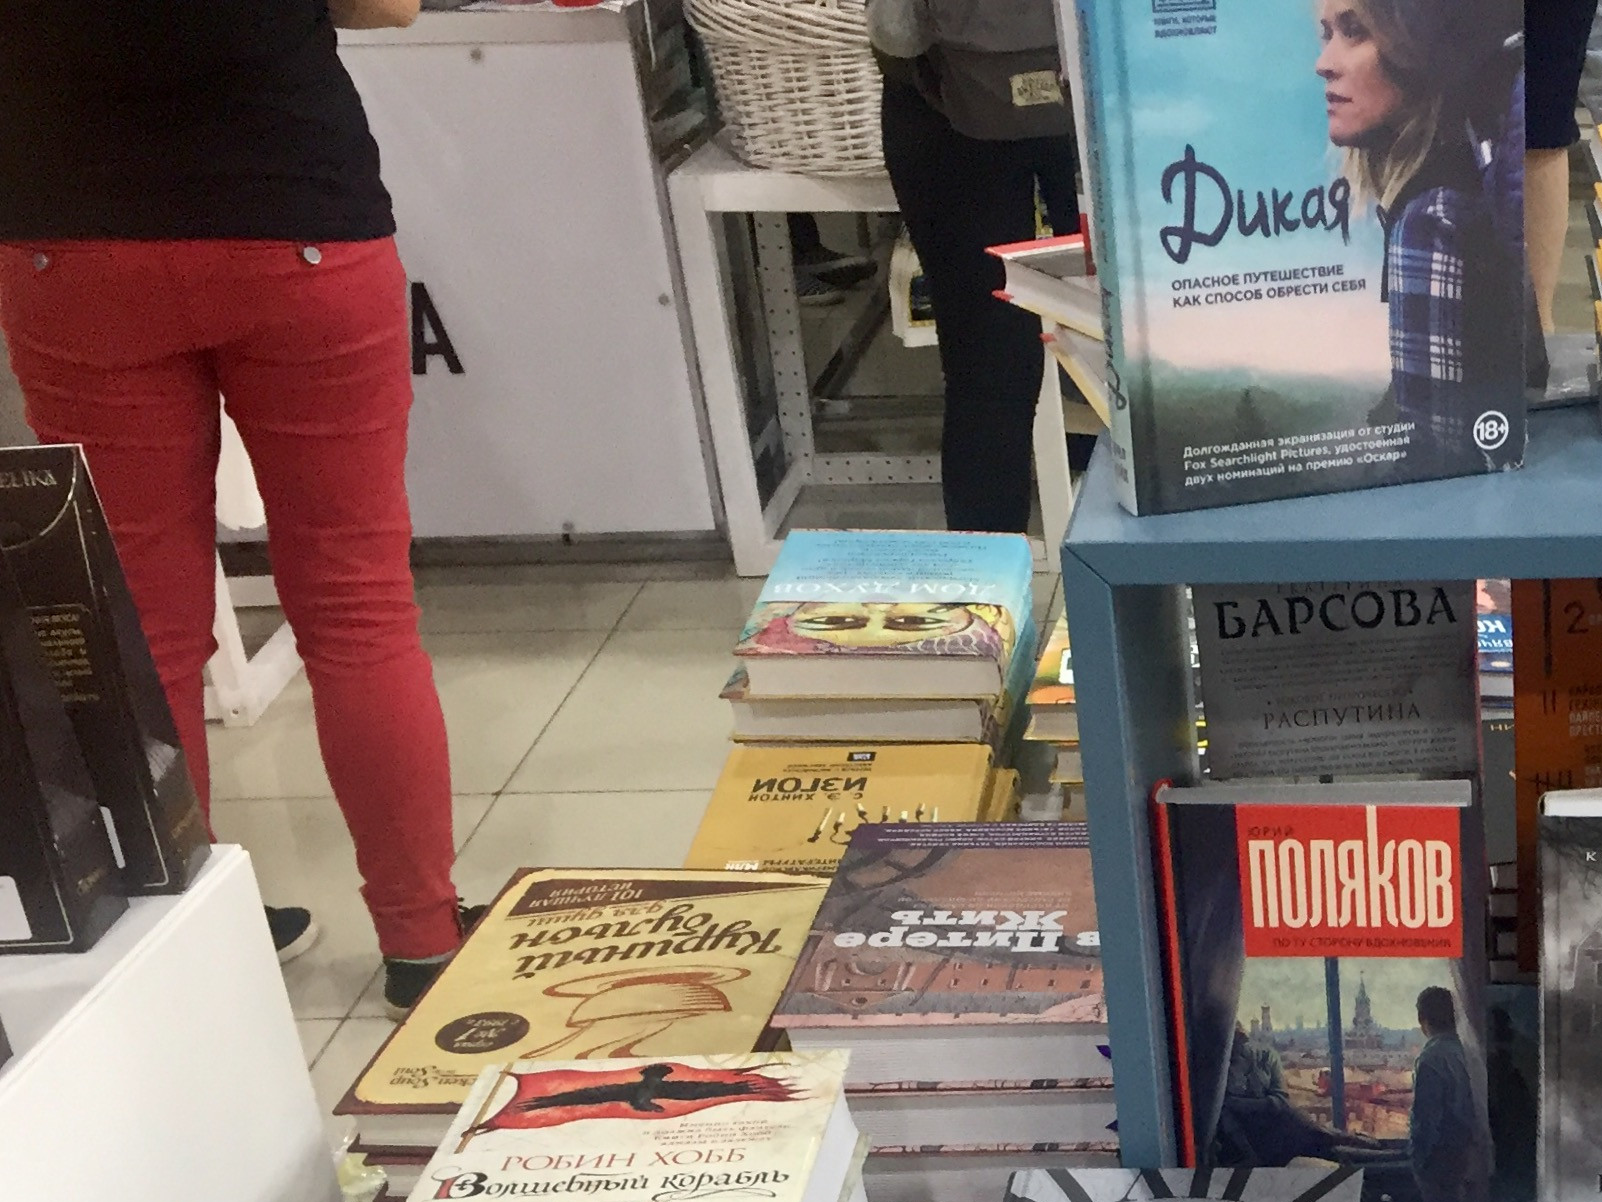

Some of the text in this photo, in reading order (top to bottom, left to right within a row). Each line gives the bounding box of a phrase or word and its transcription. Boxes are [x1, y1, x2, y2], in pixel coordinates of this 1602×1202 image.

[1160, 144, 1351, 264] Дикая
[1172, 264, 1344, 292] ОПАСНОЕ ПУТЕШЕСТВИЕ
[1173, 278, 1366, 308] КАК СПОСОБ ОБРЕСТИ СЕБЯ
[1183, 420, 1415, 459] Долгожданная экранизация от студии
[1475, 418, 1507, 441] 18+
[1185, 436, 1410, 471] Fox Searchlight Pictures, удостоенная
[1185, 450, 1408, 486] двух номинаций на премию «Оскар»
[773, 581, 995, 596] ДОМ ДУХОВ
[1212, 587, 1458, 639] БАРСОВА
[1264, 703, 1421, 730] РАСПУТИНА
[1248, 805, 1453, 929] ПОЛЯКОВ
[528, 892, 608, 908] ЛУЧШАЯ
[548, 881, 632, 898] ИСТОРИЯ
[509, 904, 712, 952] бульон
[890, 909, 1067, 930] Жить
[511, 921, 782, 980] Куриный
[833, 926, 1060, 952] Питере
[500, 1148, 747, 1171] РОБИН ХОББ
[431, 1166, 790, 1202] Волшебный корабль
